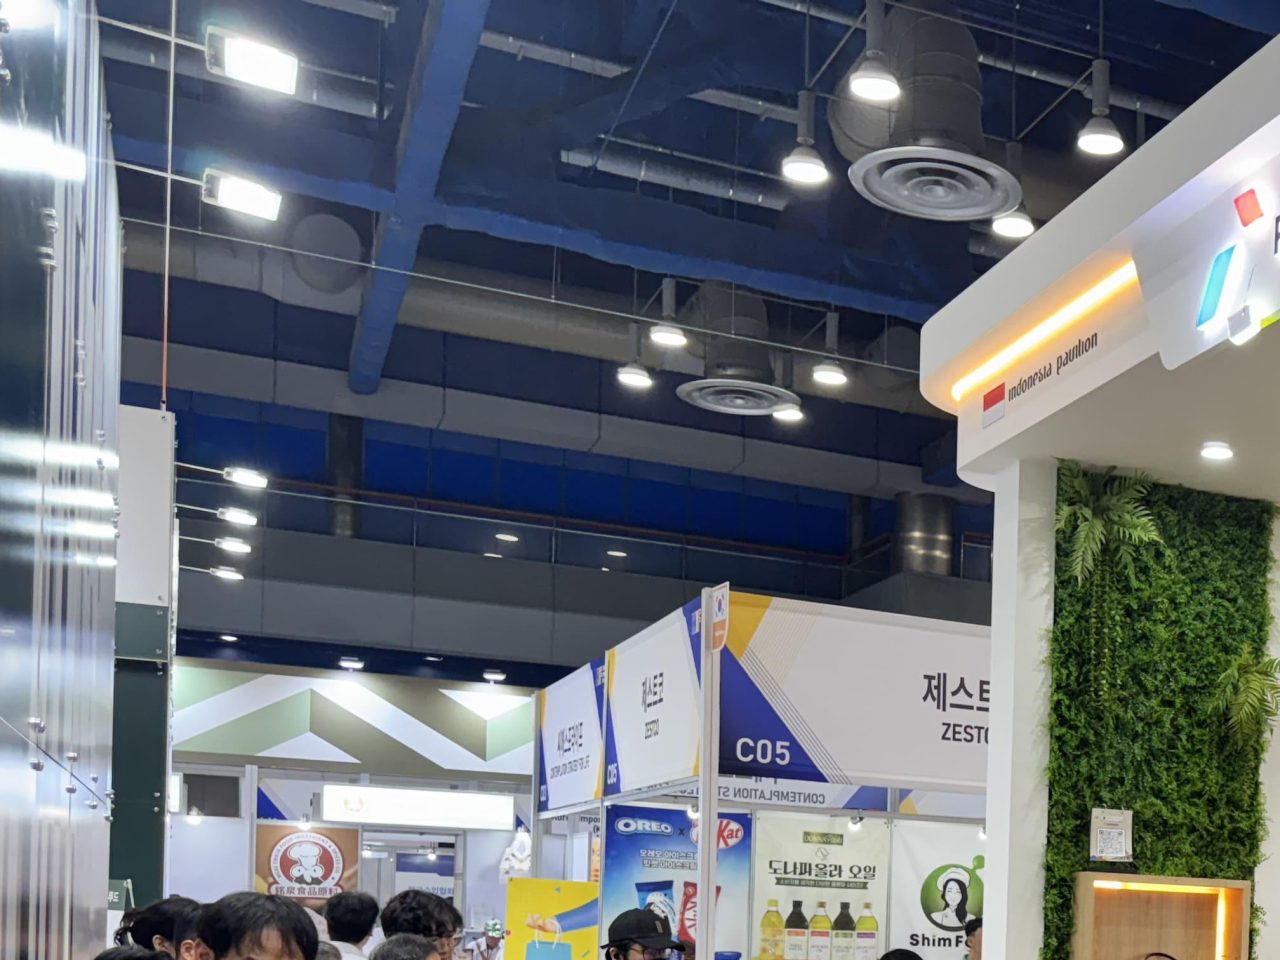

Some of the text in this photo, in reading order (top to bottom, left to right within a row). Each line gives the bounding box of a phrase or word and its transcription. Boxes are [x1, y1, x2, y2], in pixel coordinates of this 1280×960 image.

[736, 738, 790, 765] C05
[616, 819, 672, 835] OREO
[768, 860, 877, 880] 도나파올라 오일
[910, 933, 952, 947] Shim
